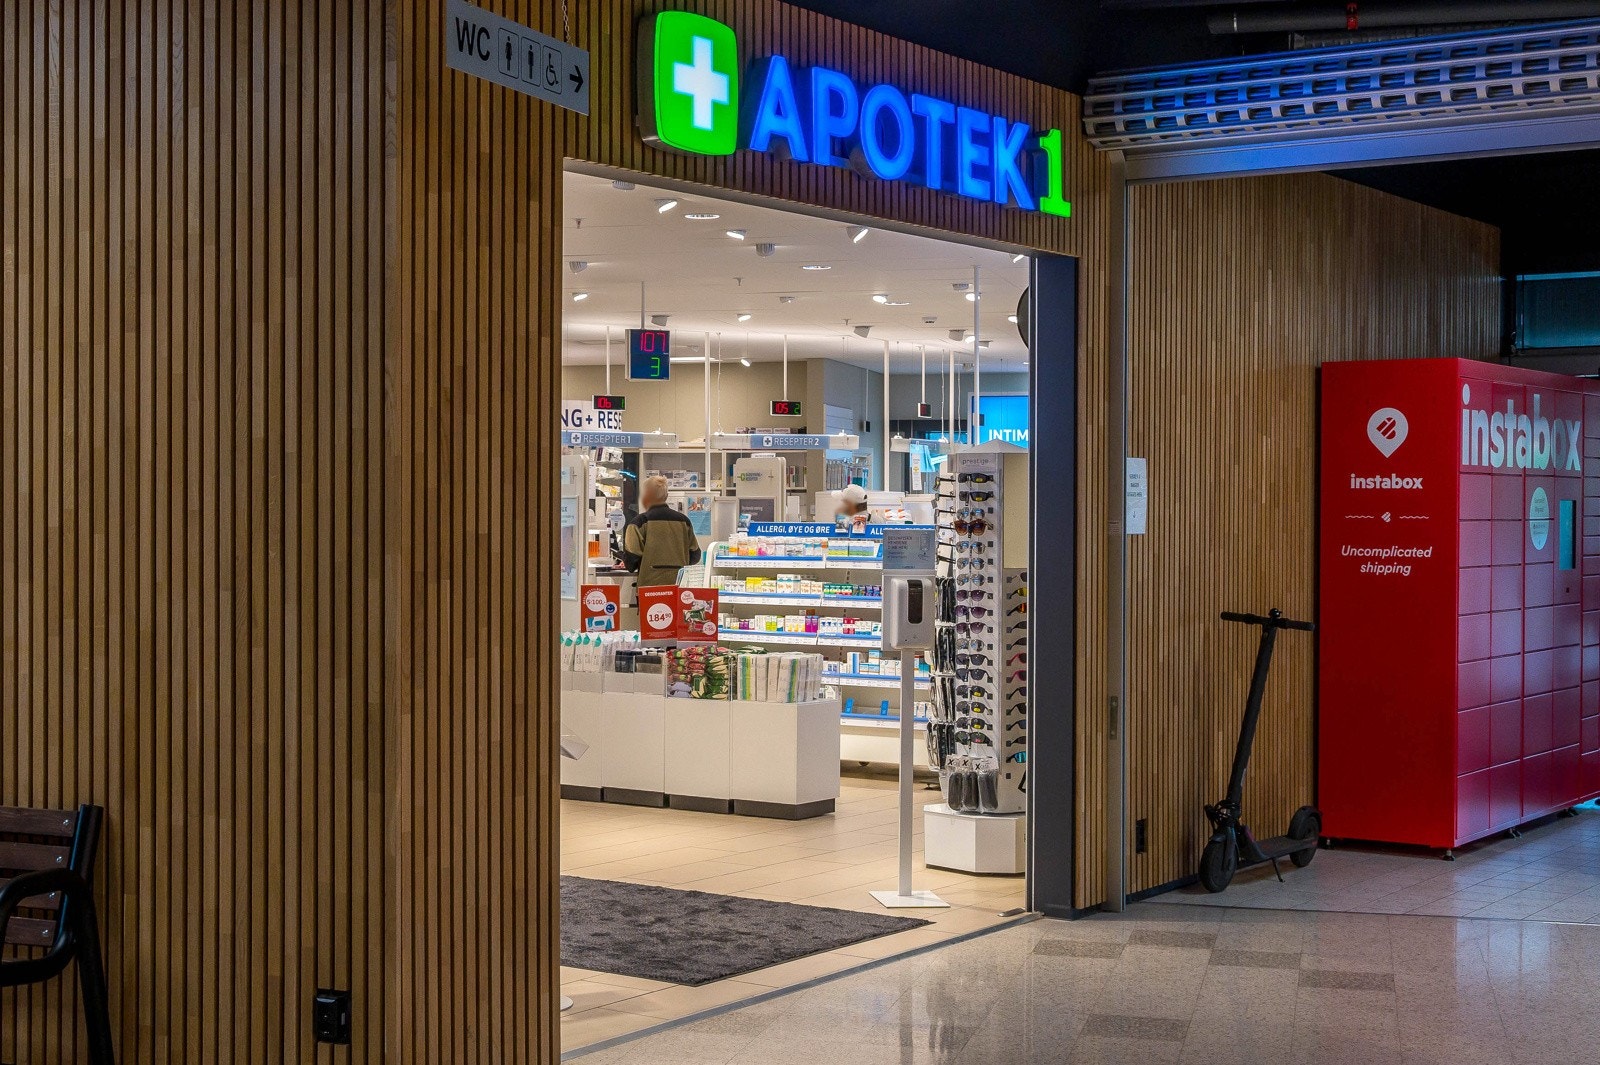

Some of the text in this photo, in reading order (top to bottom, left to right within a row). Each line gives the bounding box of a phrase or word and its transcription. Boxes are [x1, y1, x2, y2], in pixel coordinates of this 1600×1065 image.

[454, 16, 491, 62] WC
[749, 55, 1072, 219] APOTEK 1
[640, 332, 666, 352] 107
[650, 357, 660, 377] 3
[775, 403, 800, 414] 105 2
[1461, 383, 1581, 472] instabox
[583, 435, 626, 444] RESEPTER
[774, 437, 819, 446] RESEPTER 2
[988, 429, 1029, 442] INTIM
[1350, 473, 1423, 490] instabox
[756, 525, 830, 534] ALLERGI, ØYE OG ØRE
[1341, 545, 1433, 559] Uncomplicated
[1360, 562, 1411, 577] shipping
